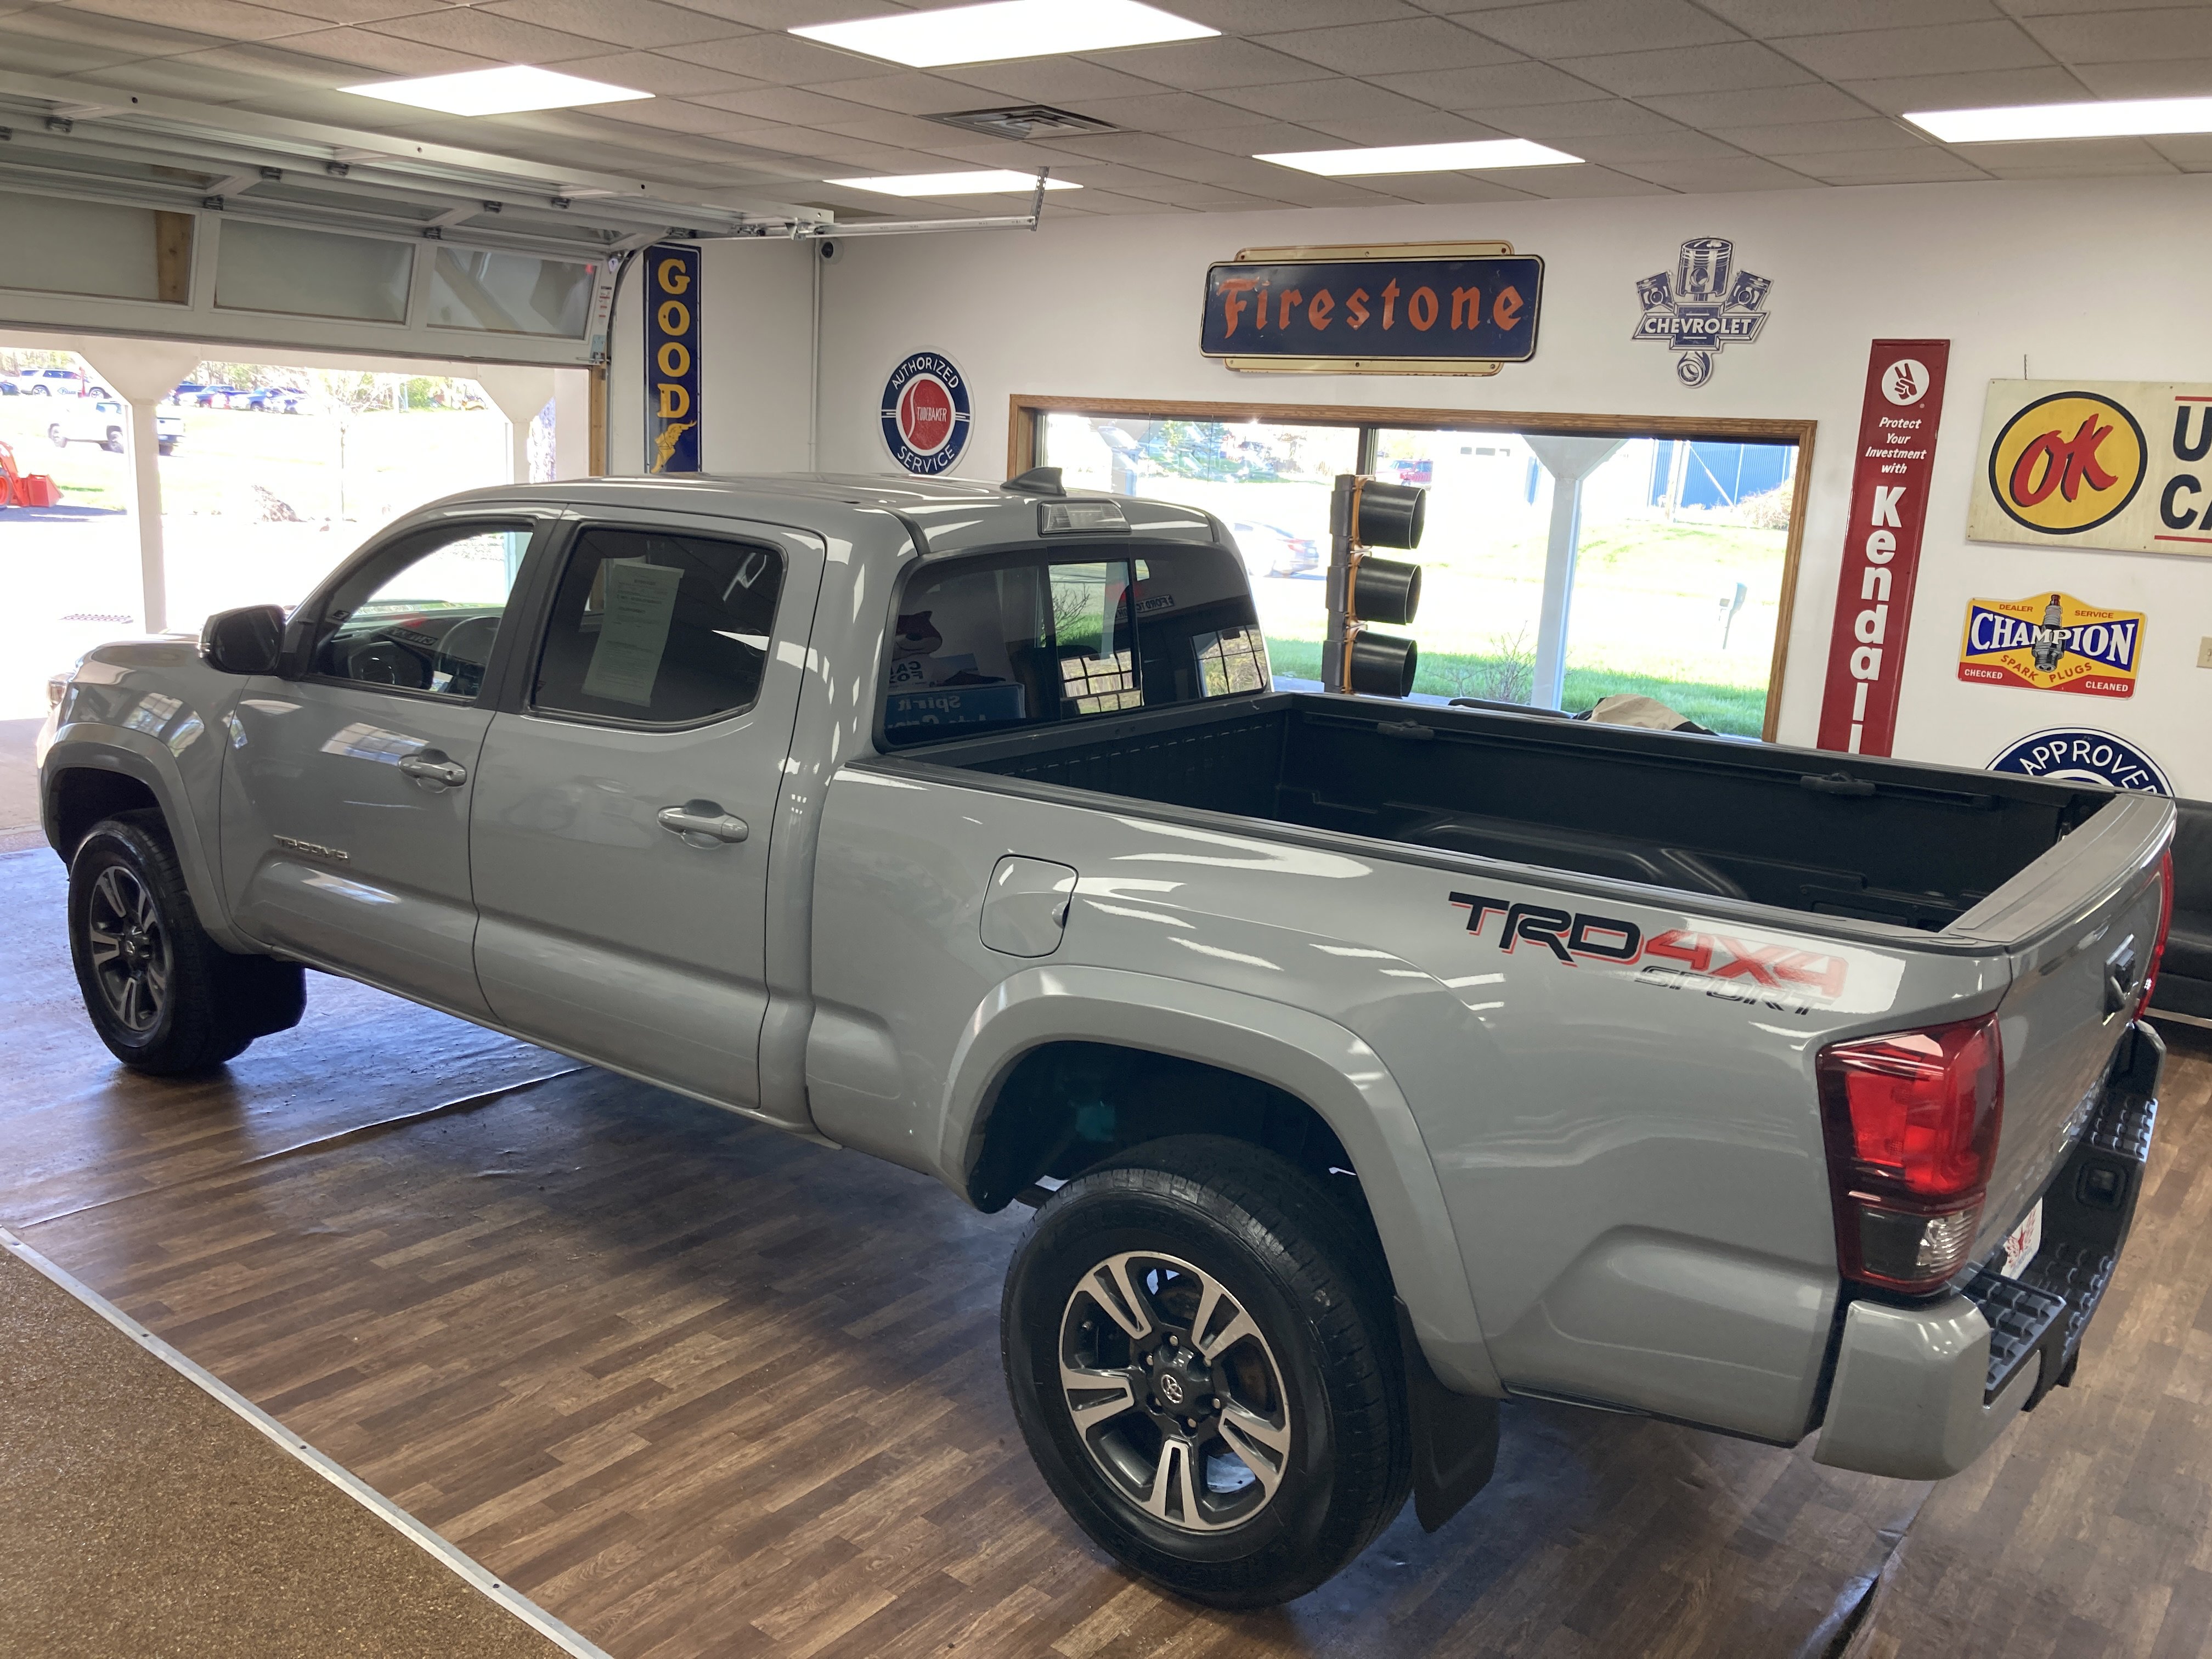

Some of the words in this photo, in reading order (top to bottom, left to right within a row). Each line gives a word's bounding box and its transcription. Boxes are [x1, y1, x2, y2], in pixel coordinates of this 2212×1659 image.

[1216, 277, 1523, 338] Firestone
[657, 258, 691, 418] GOOD
[1645, 318, 1752, 334] CHEVROLET
[892, 357, 959, 390] AUTHORIZED
[1879, 417, 1922, 429] Protect
[1865, 447, 1927, 459] Investment
[1887, 433, 1911, 444] Your
[897, 444, 955, 473] SERVICE
[1881, 463, 1908, 473] with
[2010, 413, 2118, 507] OK
[1848, 486, 1906, 754] Kendall
[1999, 604, 2033, 612] DEALER
[2075, 610, 2114, 619] SERVICE
[1971, 612, 2135, 665] CHAMPION
[1965, 669, 2003, 680] CHECKED
[2085, 681, 2129, 692] CLEANED
[2001, 654, 2039, 681] SPARK
[2049, 662, 2092, 682] PLUGS
[1448, 891, 1644, 968] TRD
[1635, 966, 1836, 1015] SPORT
